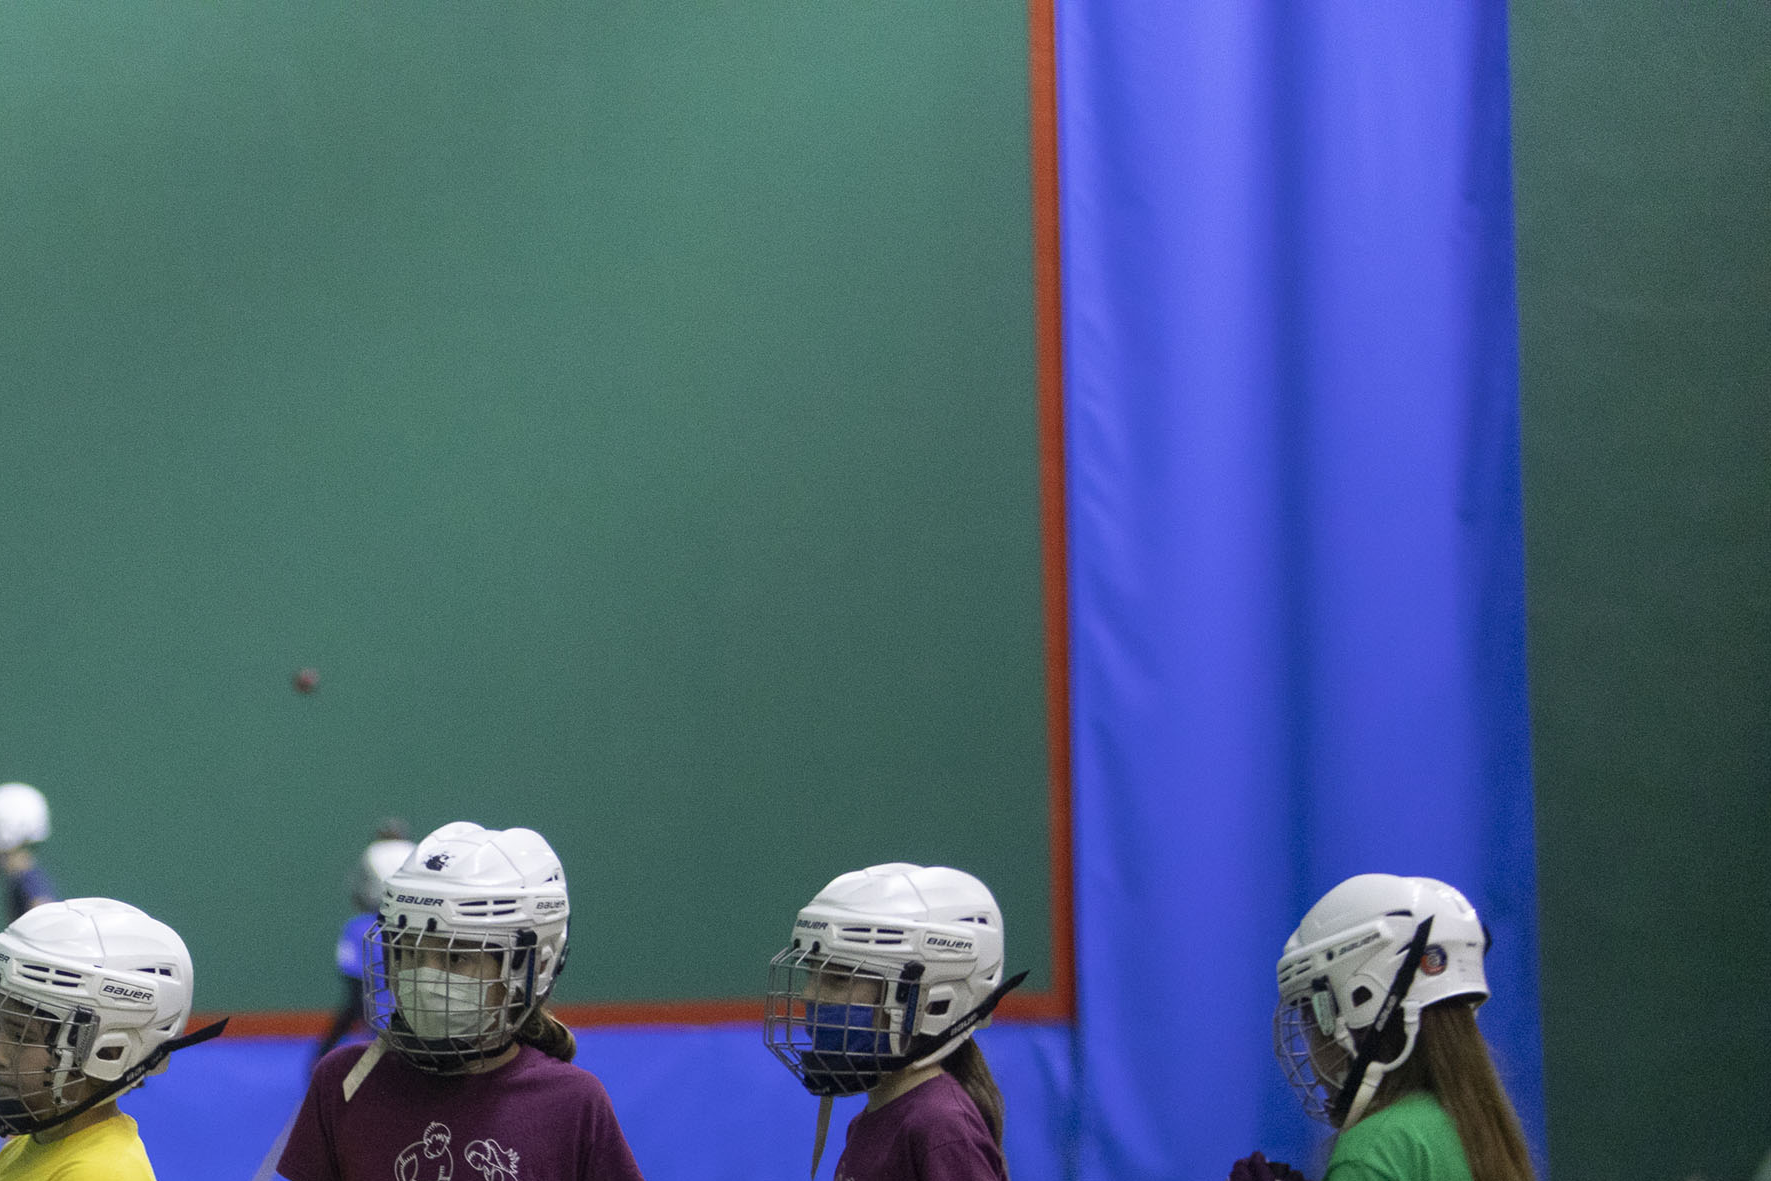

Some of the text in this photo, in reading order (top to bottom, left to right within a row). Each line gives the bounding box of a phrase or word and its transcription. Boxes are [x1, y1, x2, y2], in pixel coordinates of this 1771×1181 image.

[396, 894, 444, 907] BAUER
[536, 900, 566, 910] BAUER
[927, 937, 973, 949] BAUER
[103, 984, 154, 1001] BAUER
